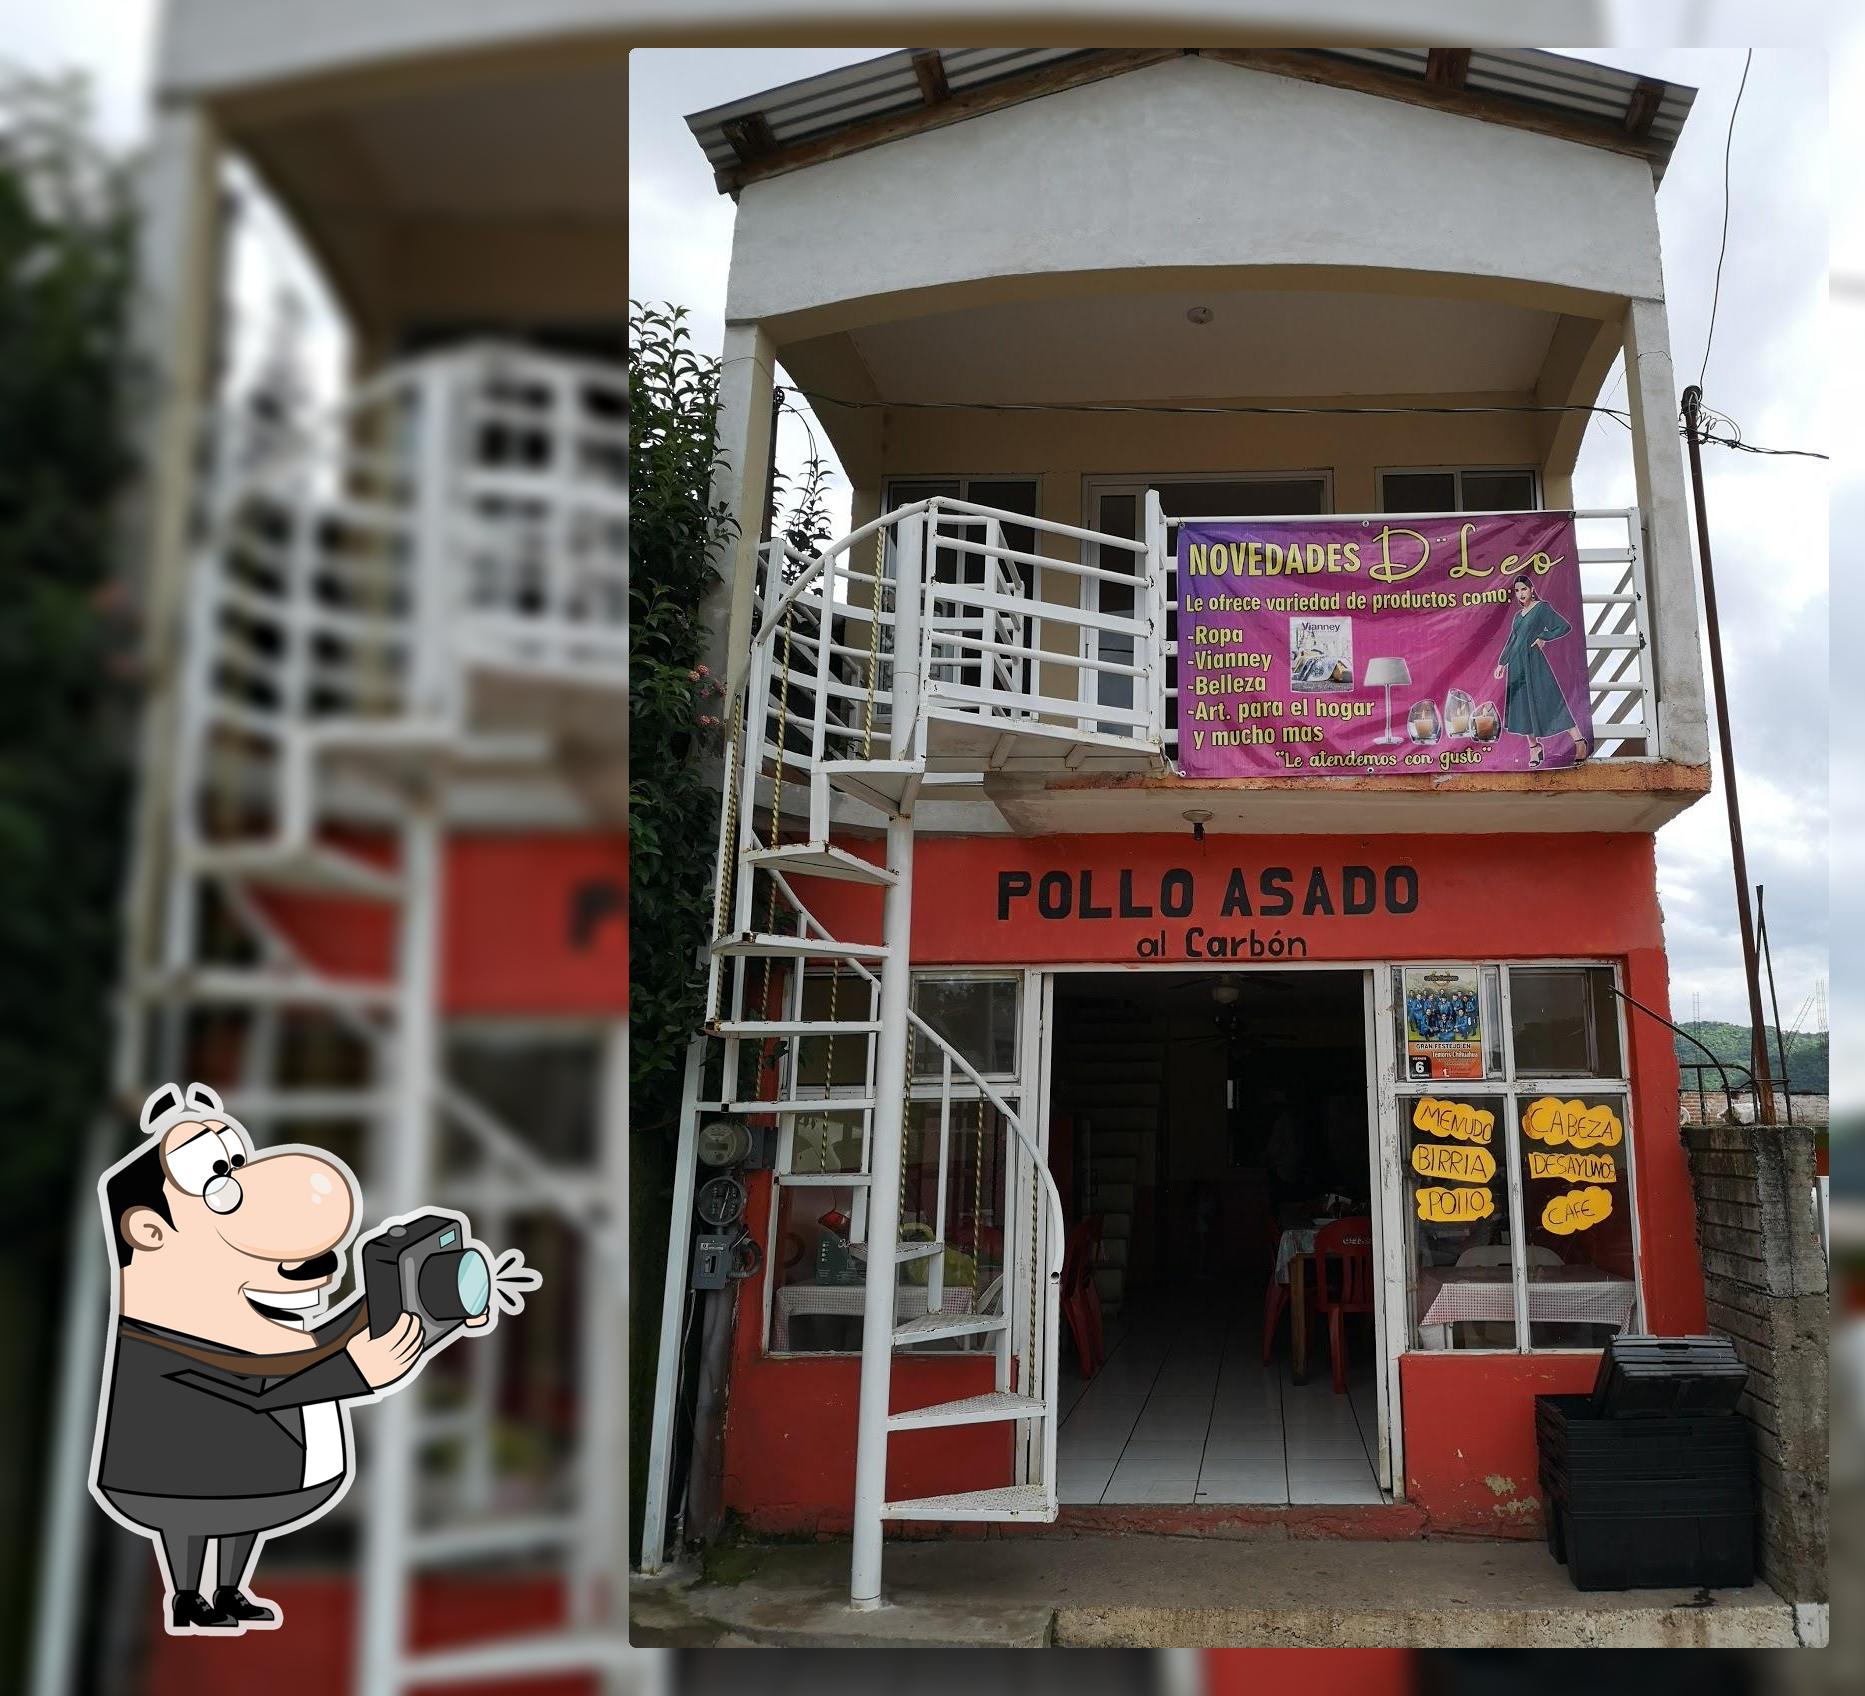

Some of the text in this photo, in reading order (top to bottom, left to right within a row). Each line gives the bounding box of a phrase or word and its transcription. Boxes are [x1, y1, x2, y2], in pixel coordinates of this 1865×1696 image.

[1189, 542, 1361, 576] NOVEDADES
[1186, 588, 1512, 613] Le ofrece variedad de productos como:
[1301, 622, 1341, 632] Vianney
[1238, 700, 1283, 723] para
[1290, 699, 1308, 716] el
[1316, 698, 1375, 720] hogar
[1193, 725, 1323, 749] y mucho mas
[1309, 750, 1397, 767] atendemos
[1404, 755, 1434, 766] con
[998, 865, 1419, 920] POLLO ASADO
[1136, 927, 1307, 958] al Carbón
[1415, 1061, 1425, 1073] 6
[1420, 1105, 1493, 1141] MENUDO
[1530, 1107, 1614, 1140] CABEZA
[1418, 1145, 1487, 1178] BIRRIA
[1547, 1199, 1596, 1224] CAFE
